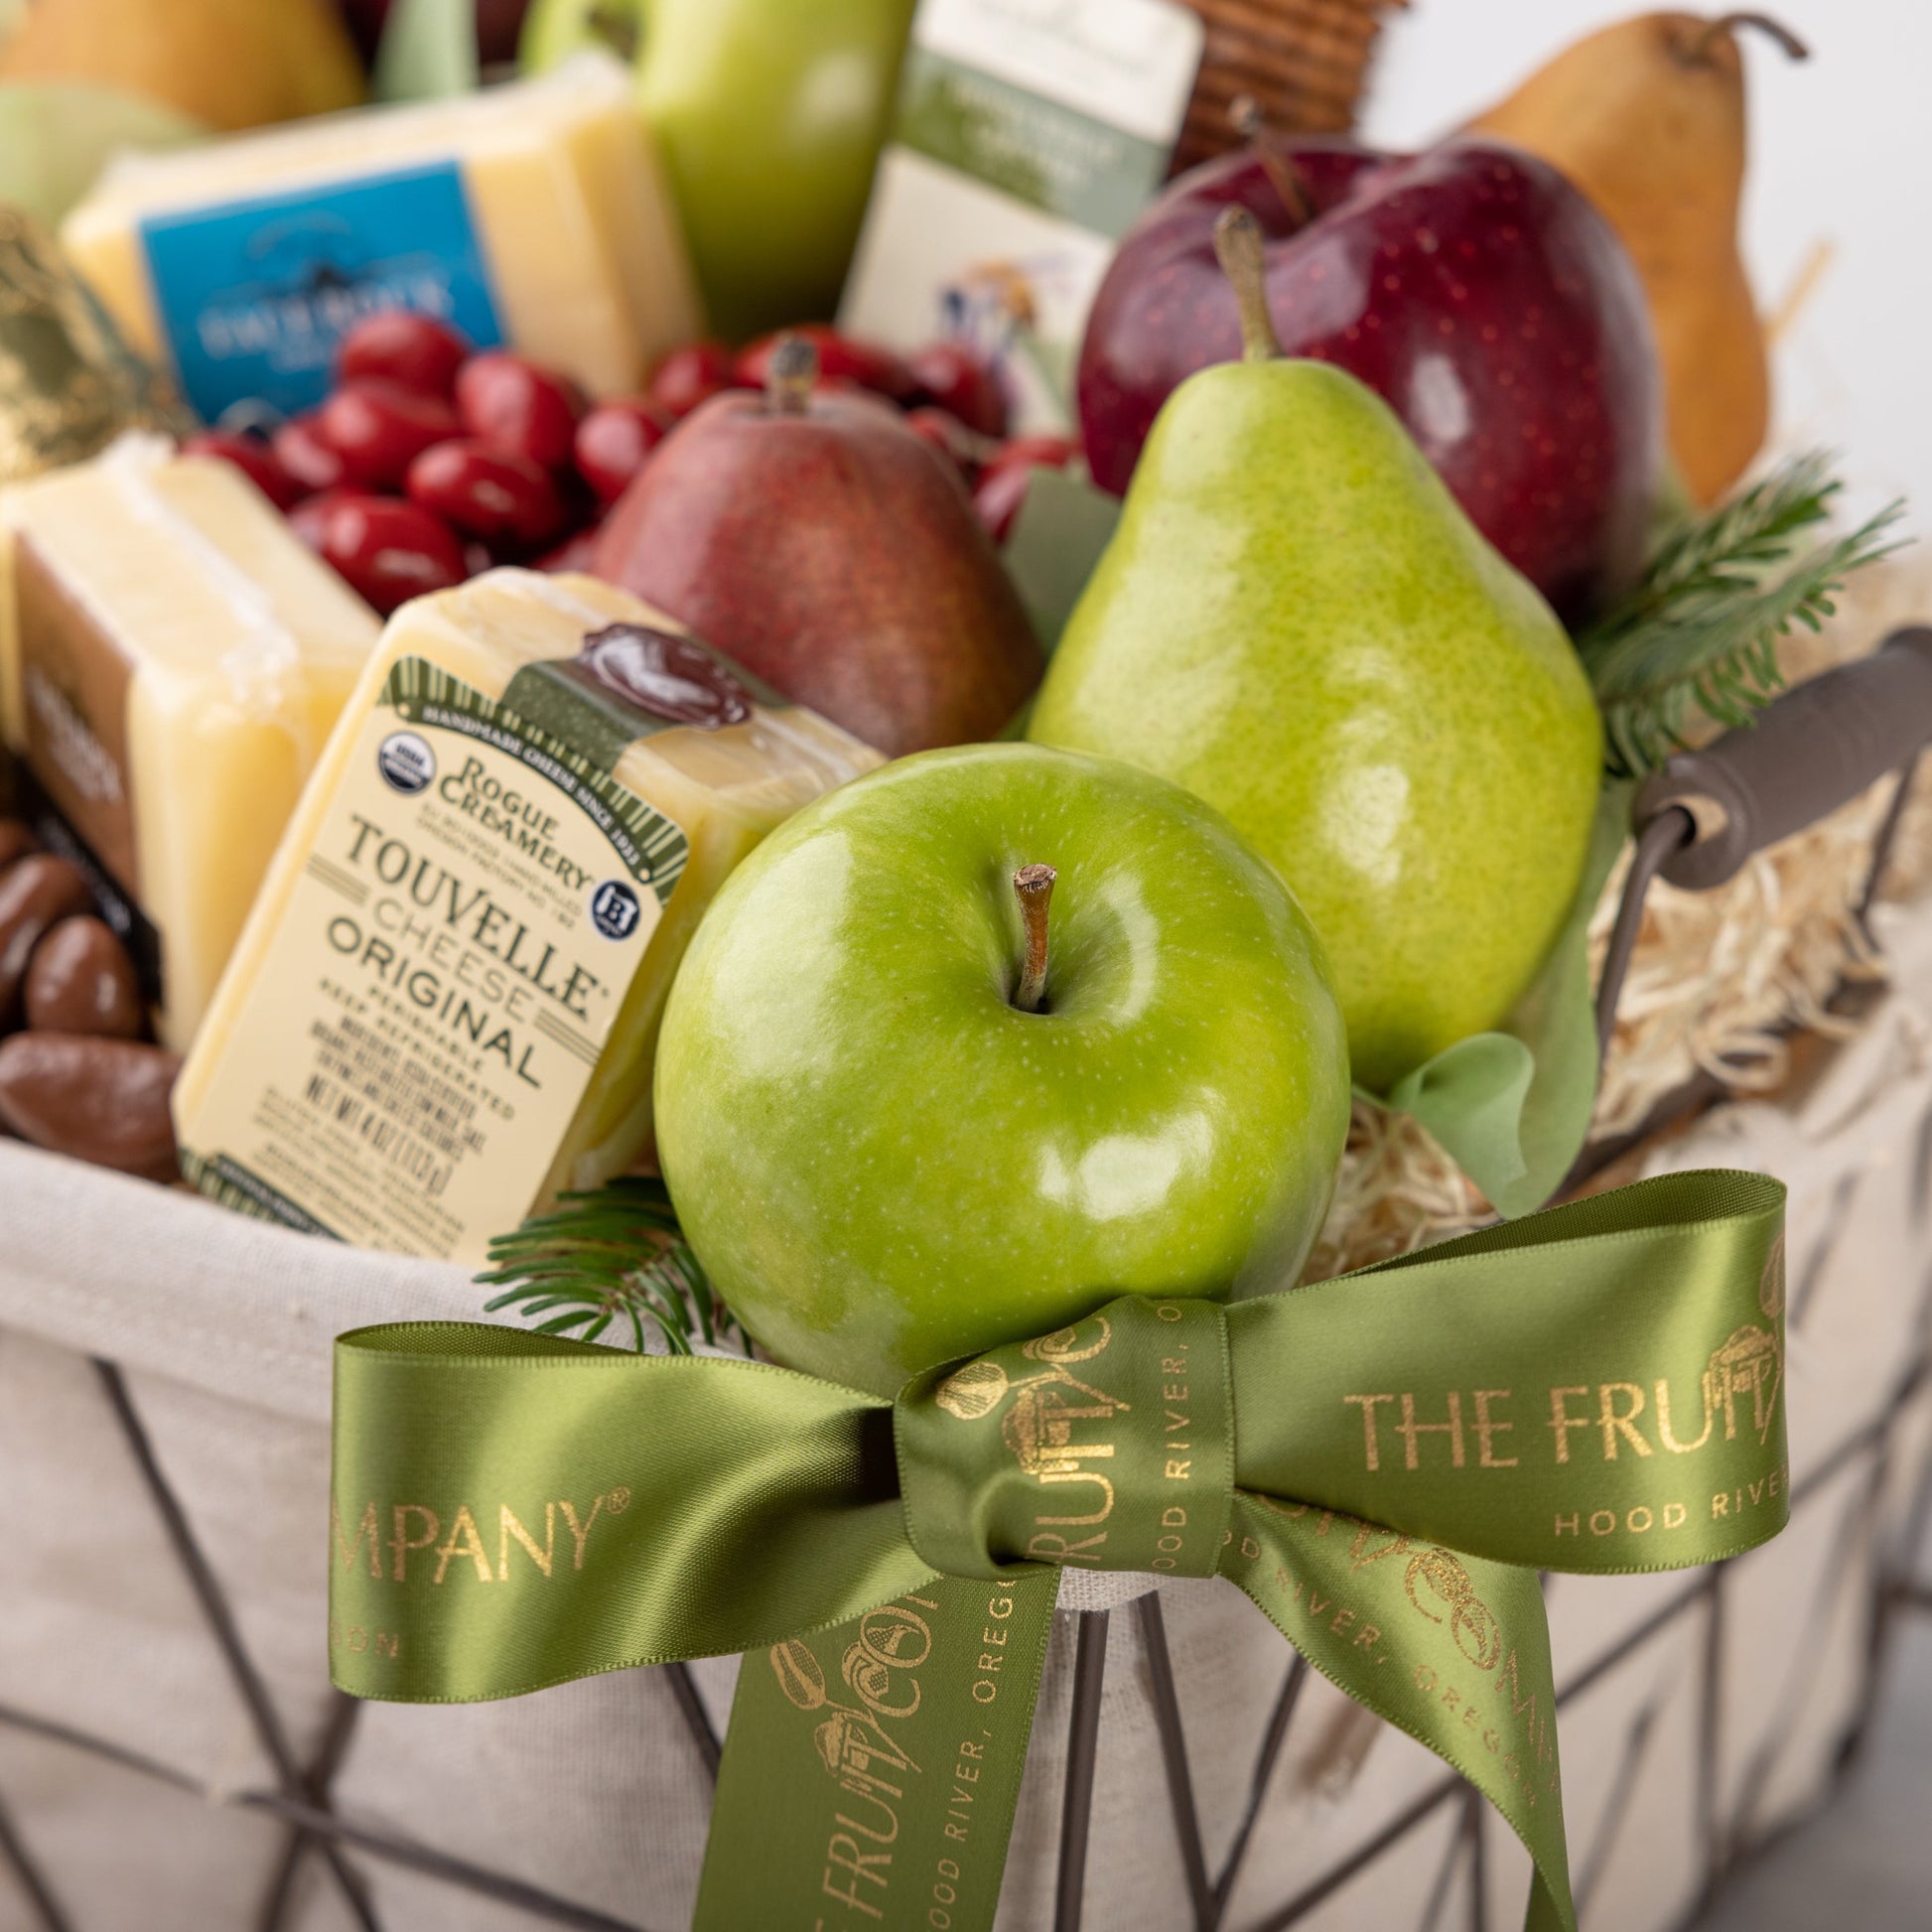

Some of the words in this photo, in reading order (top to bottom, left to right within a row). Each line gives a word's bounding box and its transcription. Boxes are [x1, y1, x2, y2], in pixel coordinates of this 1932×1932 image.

[423, 706, 523, 756] HANDMADE
[522, 747, 579, 791] CHEESE
[576, 787, 614, 829] SINCE
[462, 756, 559, 840] ROGUE
[440, 774, 592, 891] CREAMERY
[347, 812, 602, 1023] TOUVELLE
[373, 897, 535, 1024] CHEESE
[320, 977, 367, 1012] KEEP
[376, 1018, 515, 1121] REFRIGERATED
[327, 915, 541, 1090] ORIGINAL
[368, 985, 483, 1073] PERISHABLE
[1163, 1342, 1190, 1479] RIVER,
[1343, 1390, 1518, 1471] THE
[1547, 1354, 1776, 1464] FRUIT
[1554, 1503, 1687, 1537] HOOD
[944, 1729, 992, 1842] RIVER,
